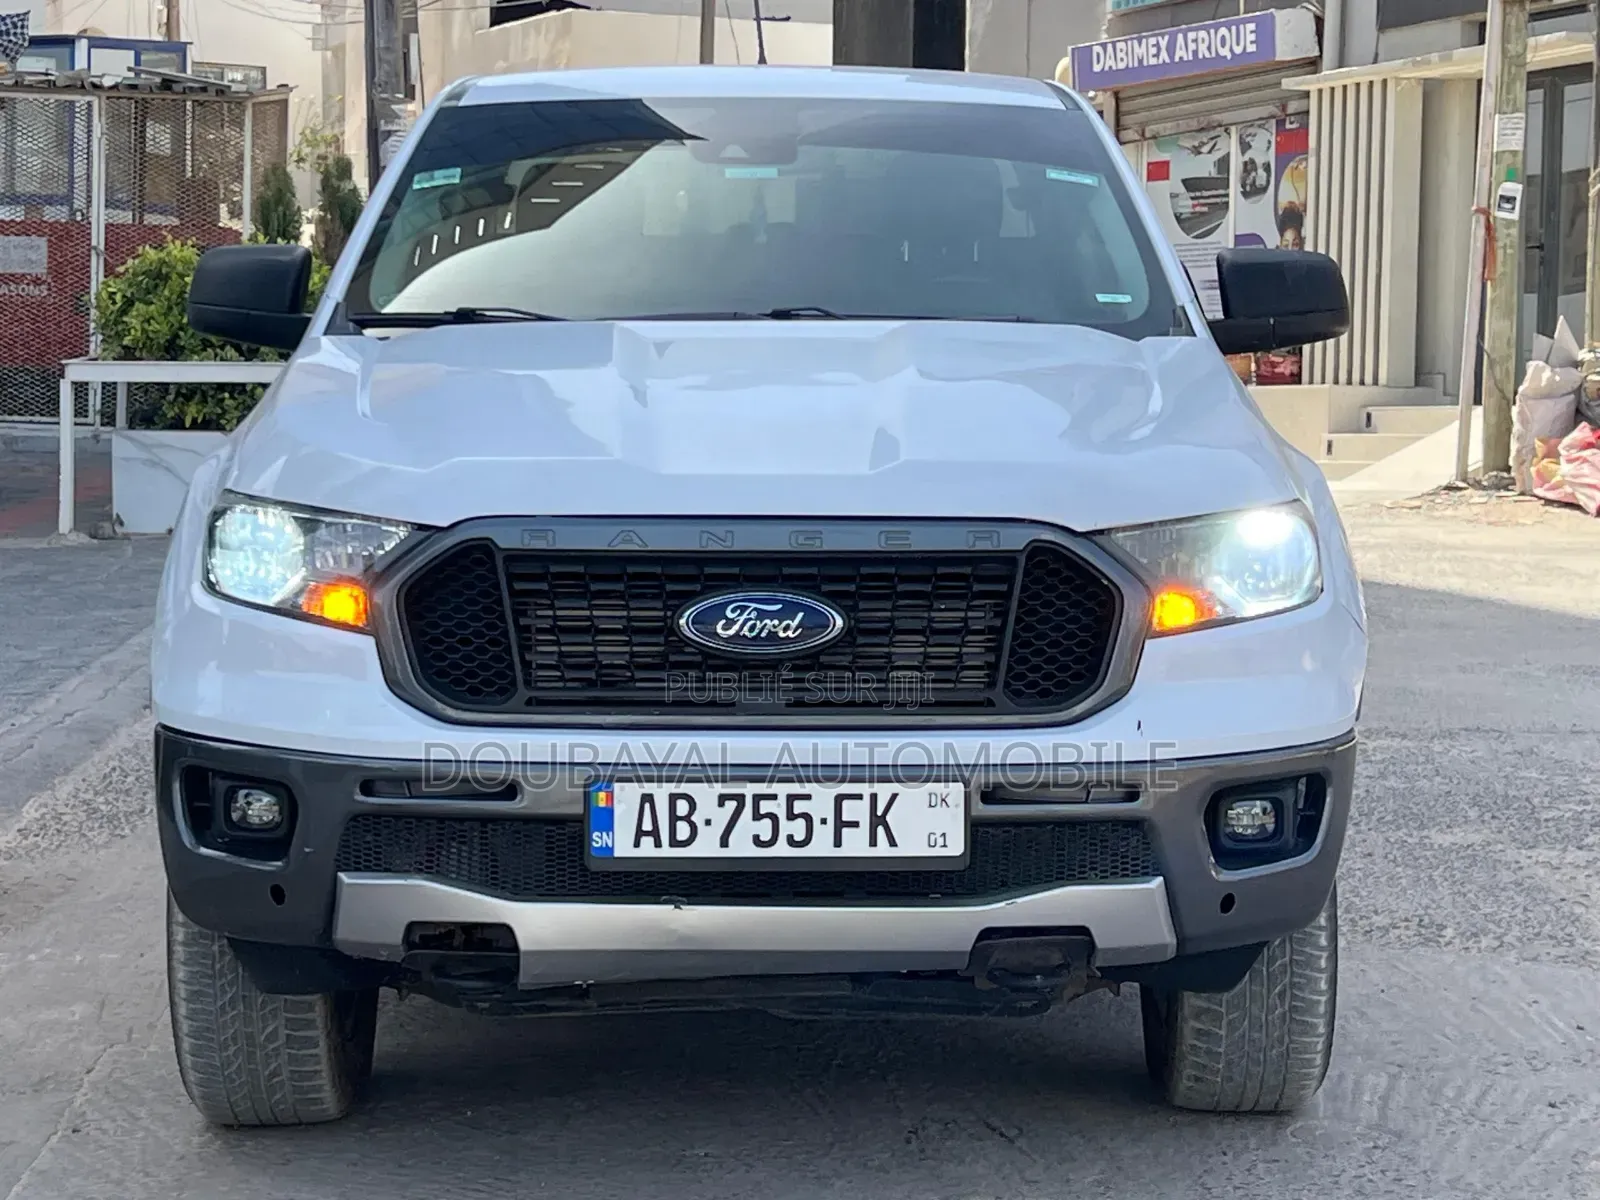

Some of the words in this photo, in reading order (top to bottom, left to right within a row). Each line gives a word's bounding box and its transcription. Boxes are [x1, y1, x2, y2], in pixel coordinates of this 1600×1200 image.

[1092, 35, 1170, 73] DABIMEX
[1174, 23, 1257, 60] AFRIQUE
[520, 528, 1001, 549] RANGER
[715, 601, 805, 639] Ford
[927, 792, 951, 809] DK
[591, 831, 613, 849] SN
[927, 832, 949, 849] 01
